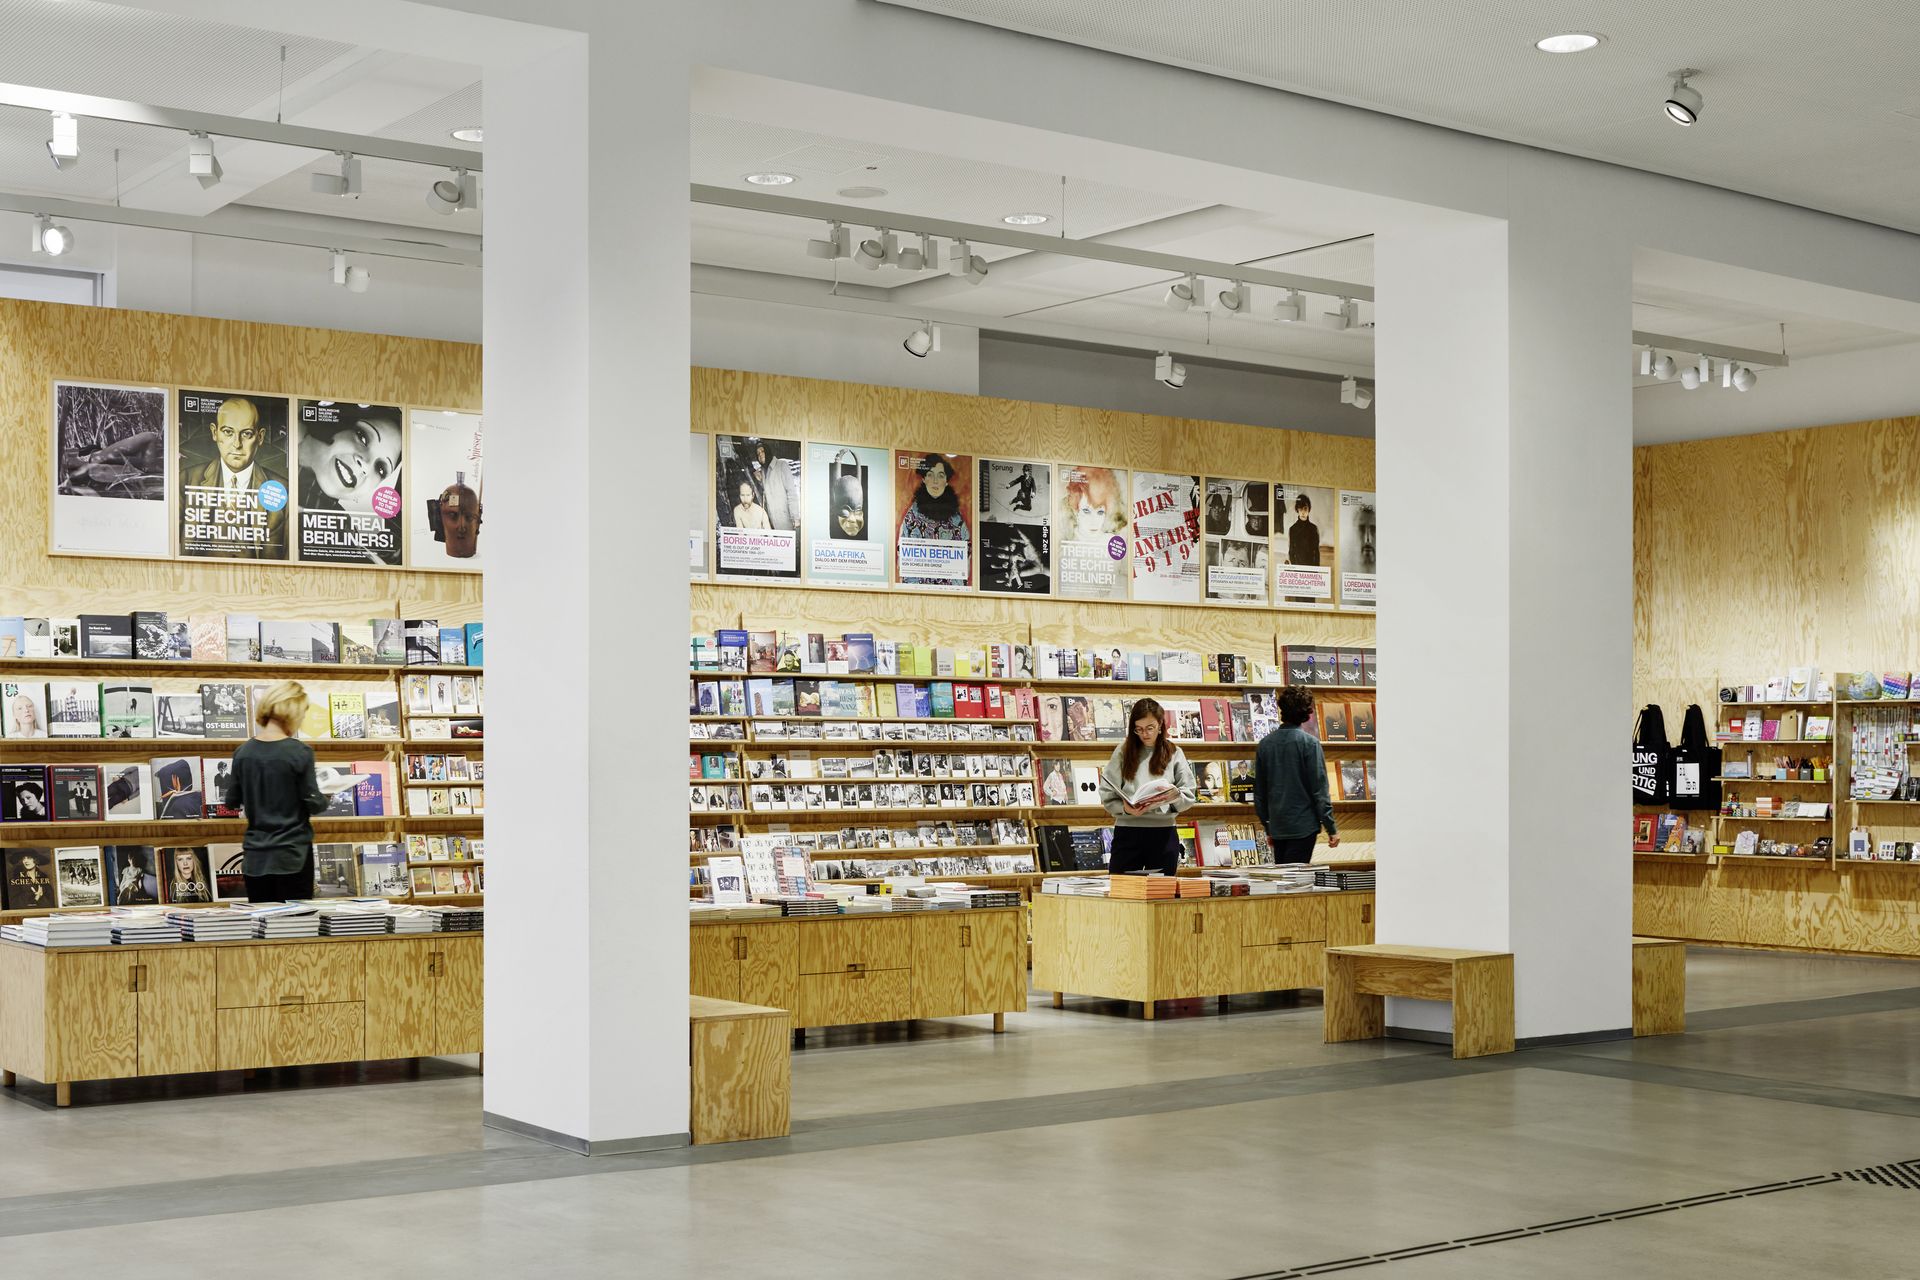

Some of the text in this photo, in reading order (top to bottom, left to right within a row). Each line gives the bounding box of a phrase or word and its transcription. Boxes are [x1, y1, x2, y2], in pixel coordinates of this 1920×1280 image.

[991, 463, 1014, 473] Sprung
[184, 491, 258, 509] TREFFEN
[184, 508, 268, 526] SIE ECHTE
[303, 514, 391, 532] MEET REAL
[1043, 517, 1048, 526] in
[184, 524, 270, 542] BERLINER!
[303, 530, 394, 548] BERLINERS!
[723, 536, 791, 548] BORIS MIKHAILOV
[814, 549, 866, 559] DADA AFRIKA
[902, 547, 964, 560] WIEN BERLIN
[1060, 558, 1114, 572] SIE ECHTE
[1060, 571, 1116, 585] BERLINER!
[1299, 572, 1323, 580] MAMMEN
[1288, 578, 1326, 587] BEOBACHTERIN
[1344, 580, 1371, 589] LOREDANA
[1632, 752, 1658, 764] UNG
[1638, 767, 1656, 775] UND
[10, 877, 50, 886] SCHENKER
[175, 881, 205, 892] 1000
